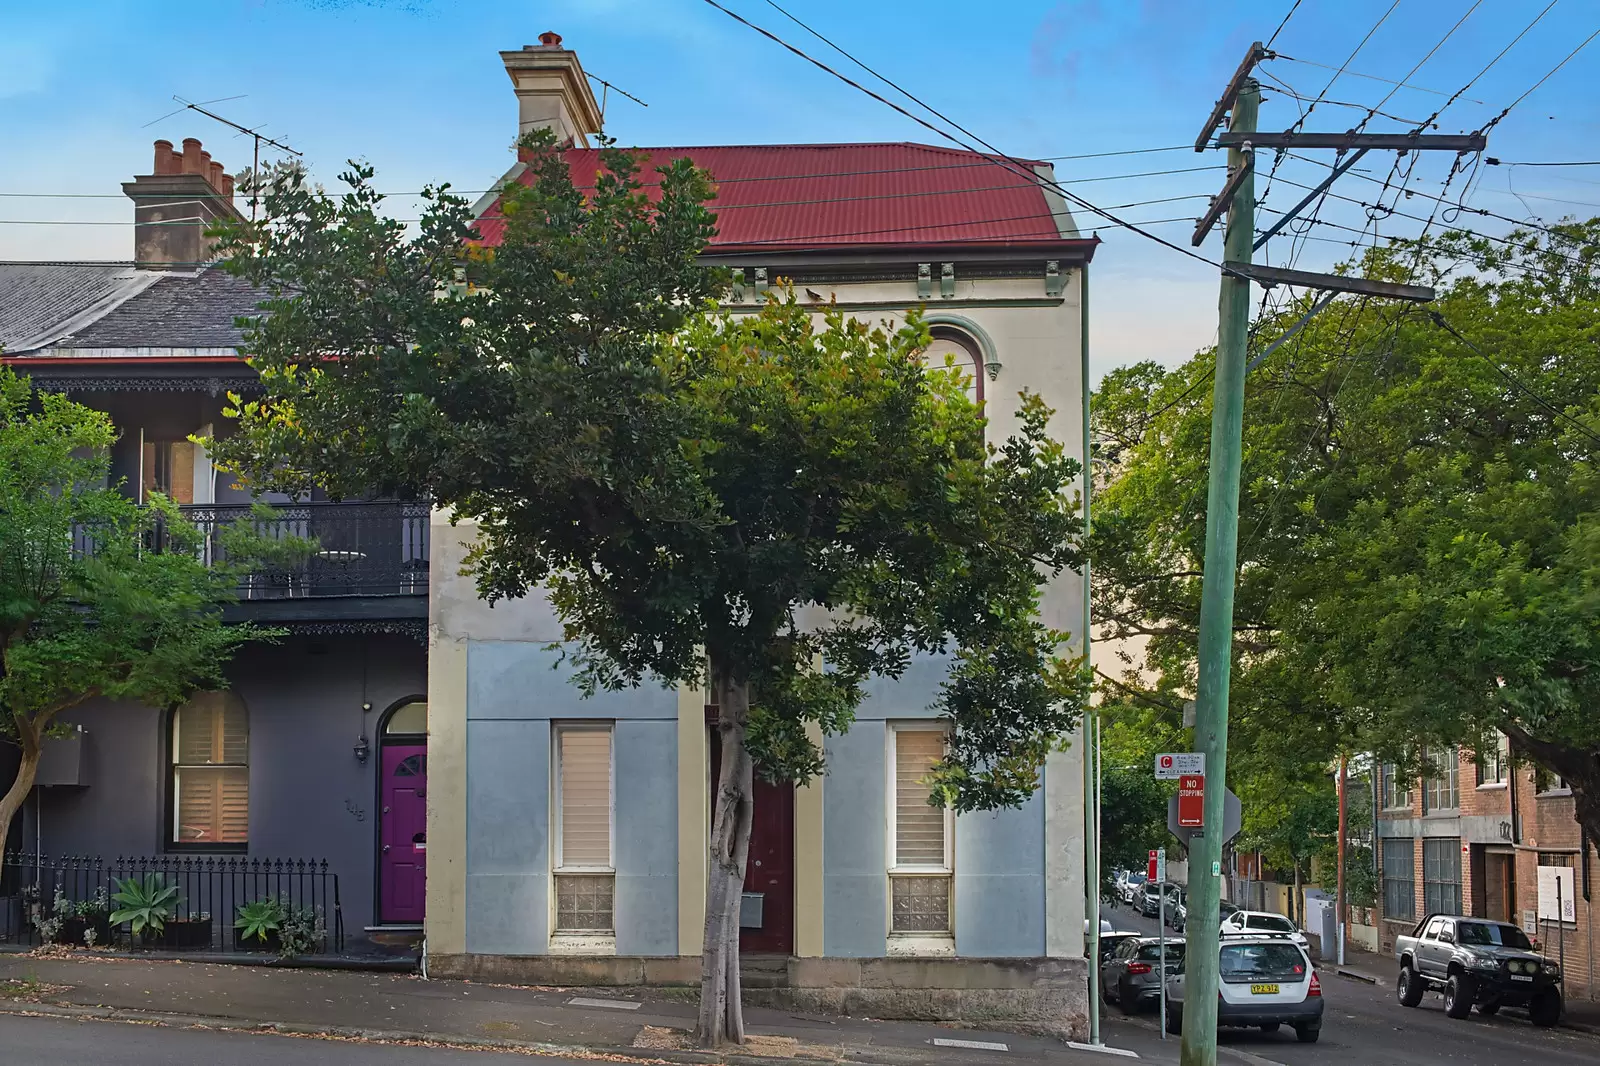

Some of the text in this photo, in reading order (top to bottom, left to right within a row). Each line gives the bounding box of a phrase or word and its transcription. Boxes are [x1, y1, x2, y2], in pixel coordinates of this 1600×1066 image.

[1163, 757, 1170, 767] C
[1186, 780, 1197, 788] NO
[1180, 789, 1204, 797] STOPPING
